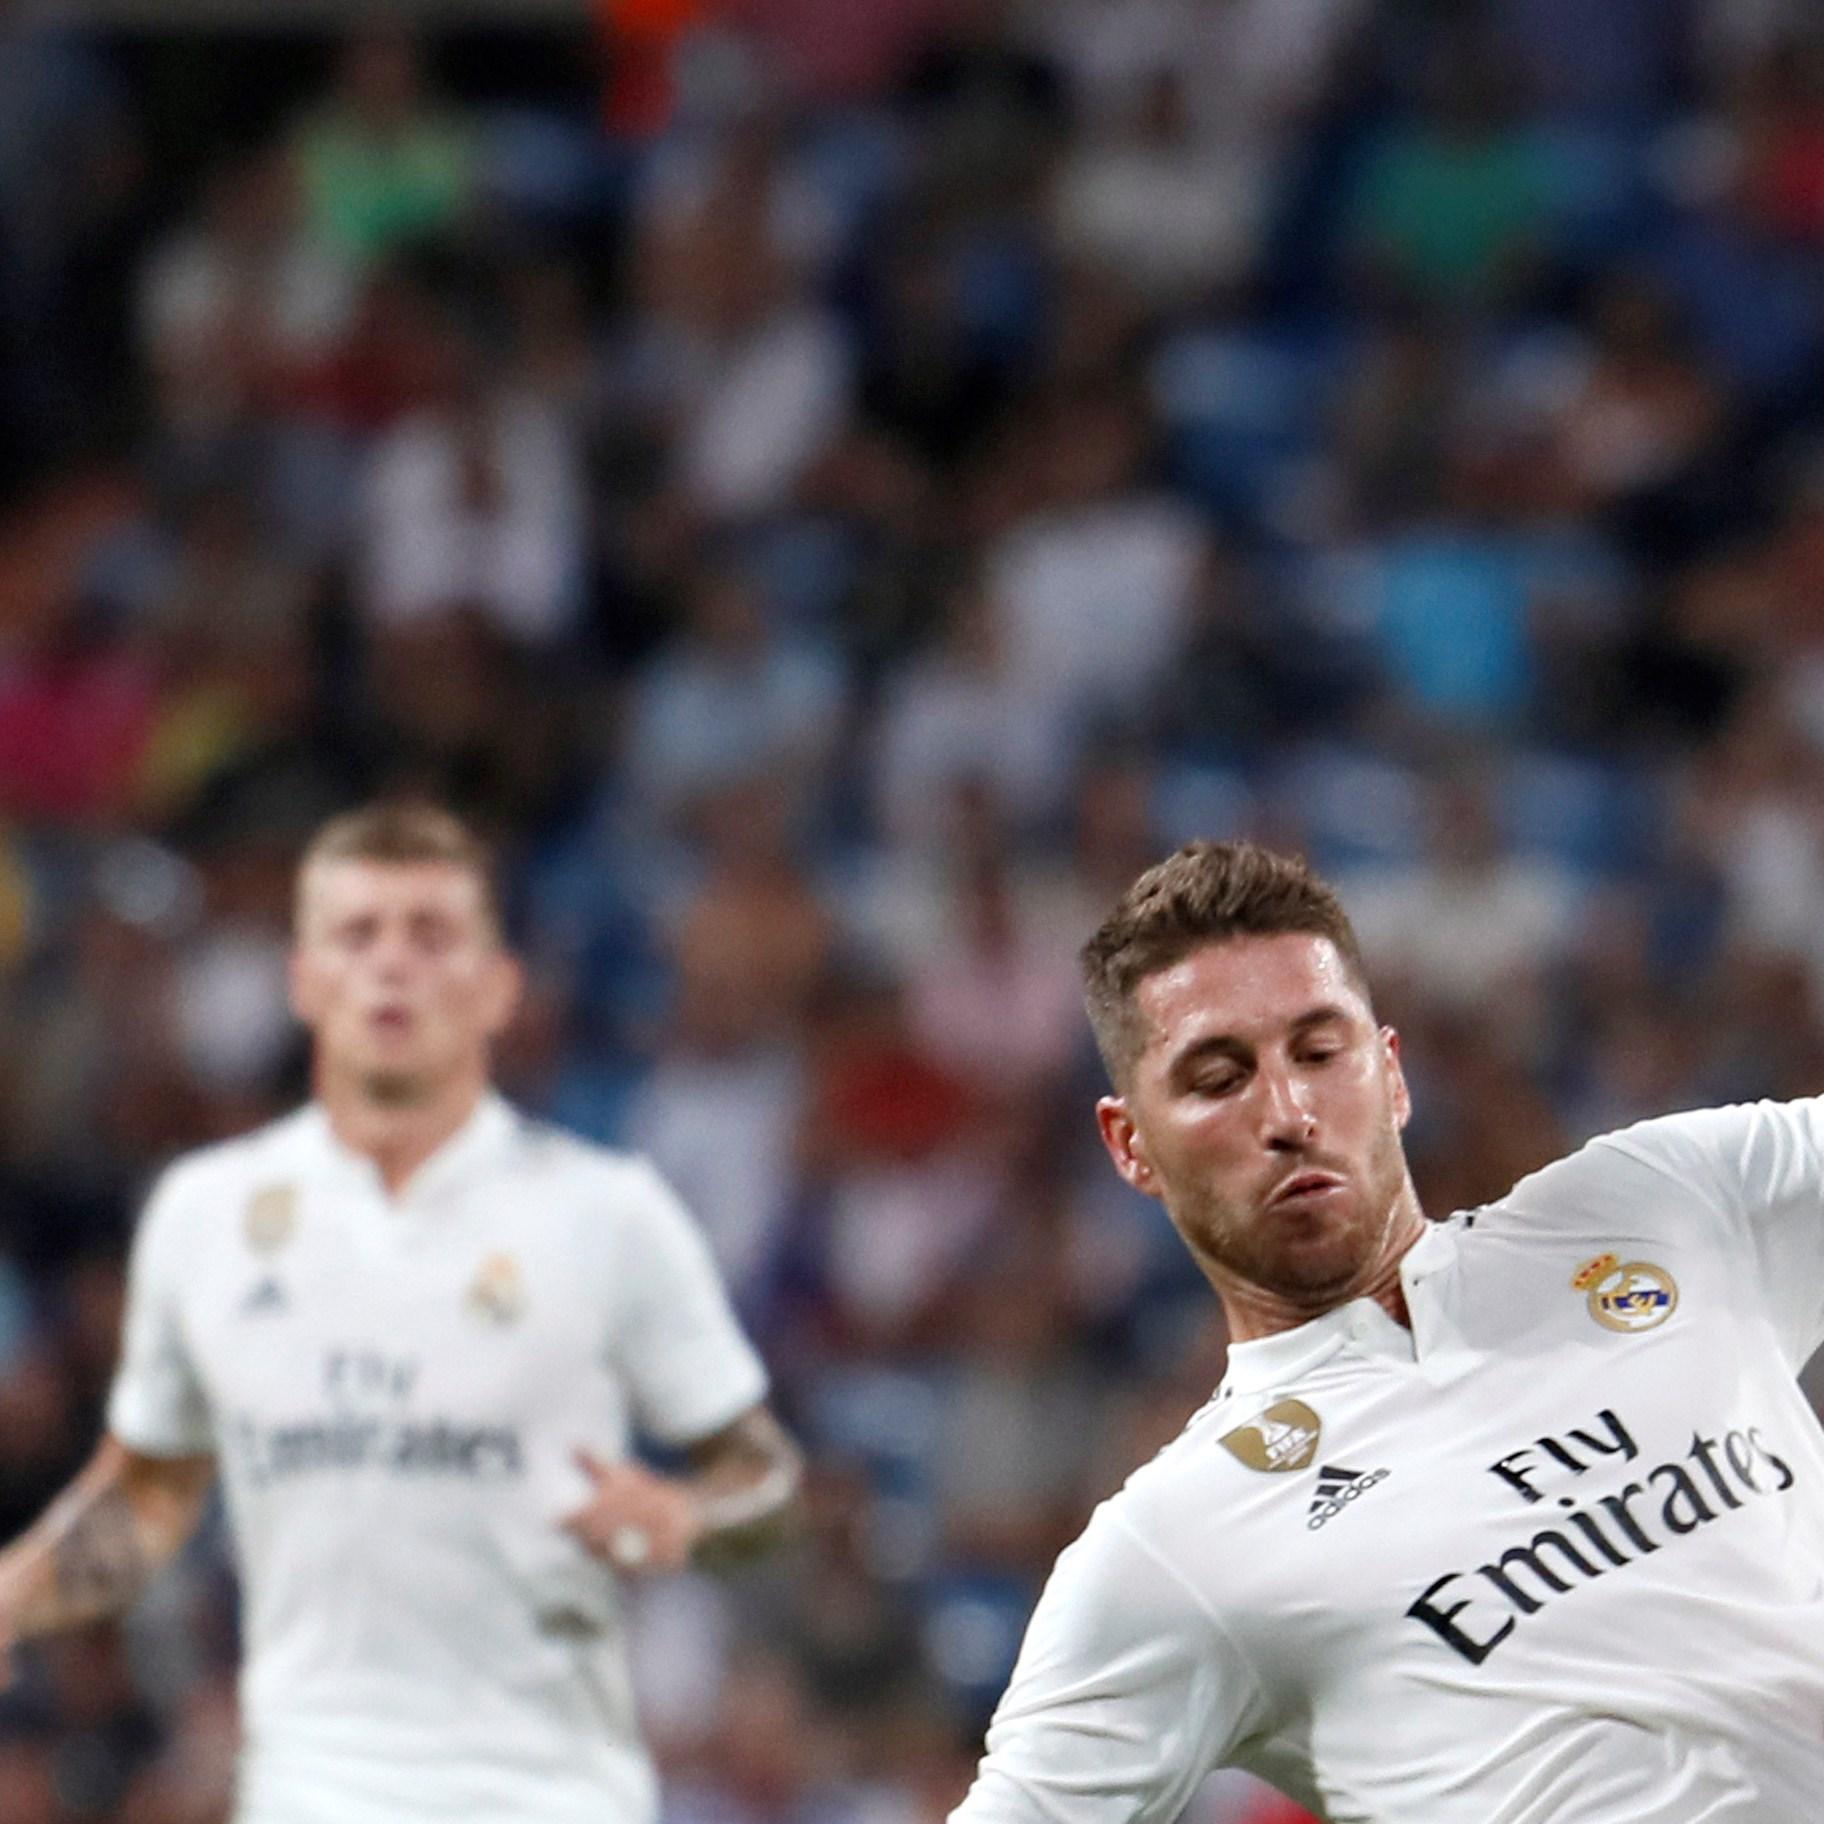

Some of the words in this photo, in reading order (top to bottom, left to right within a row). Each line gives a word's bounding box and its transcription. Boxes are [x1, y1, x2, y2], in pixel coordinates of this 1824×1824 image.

[1307, 1467, 1391, 1531] adidas
[1488, 1408, 1639, 1503] Fly
[1404, 1426, 1795, 1666] Emirates
